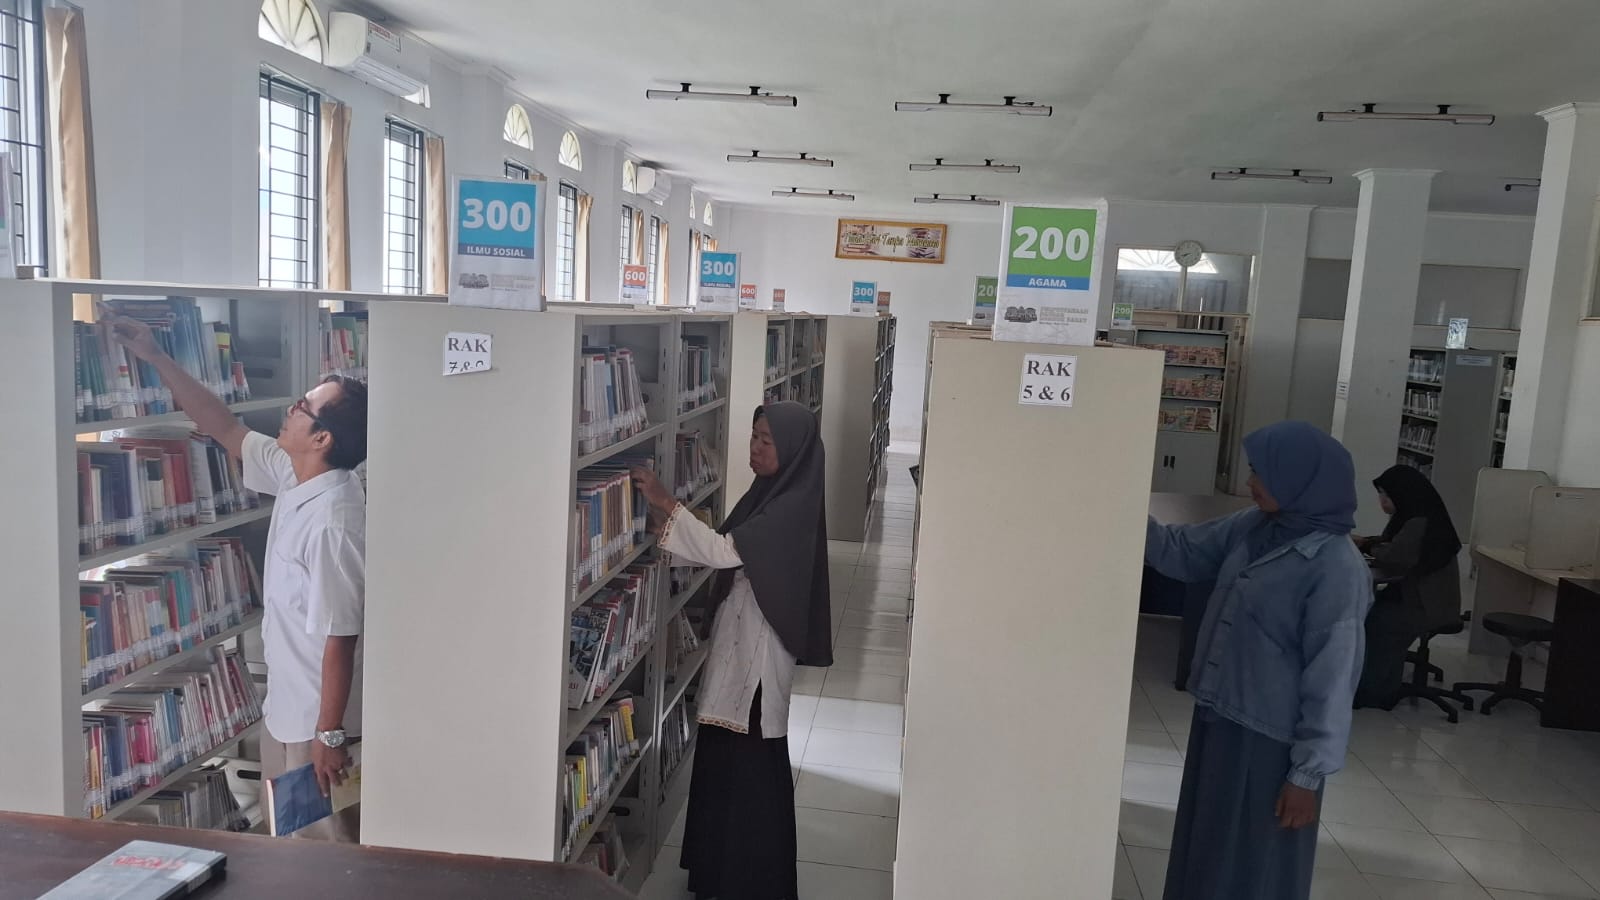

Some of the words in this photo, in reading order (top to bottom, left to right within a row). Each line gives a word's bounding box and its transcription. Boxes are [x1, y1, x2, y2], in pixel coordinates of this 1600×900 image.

[462, 198, 532, 232] 300
[466, 245, 491, 256] ILMU
[493, 247, 526, 257] SOSIAL
[1012, 226, 1090, 262] 200
[624, 270, 646, 281] 600
[702, 260, 735, 276] 300
[1028, 277, 1067, 288] AGAMA
[853, 287, 873, 296] 300
[447, 337, 488, 353] RAK
[449, 361, 458, 373] 7
[1026, 360, 1073, 377] RAK
[1023, 384, 1033, 399] 5
[1039, 385, 1054, 401] &
[1060, 387, 1070, 402] 6
